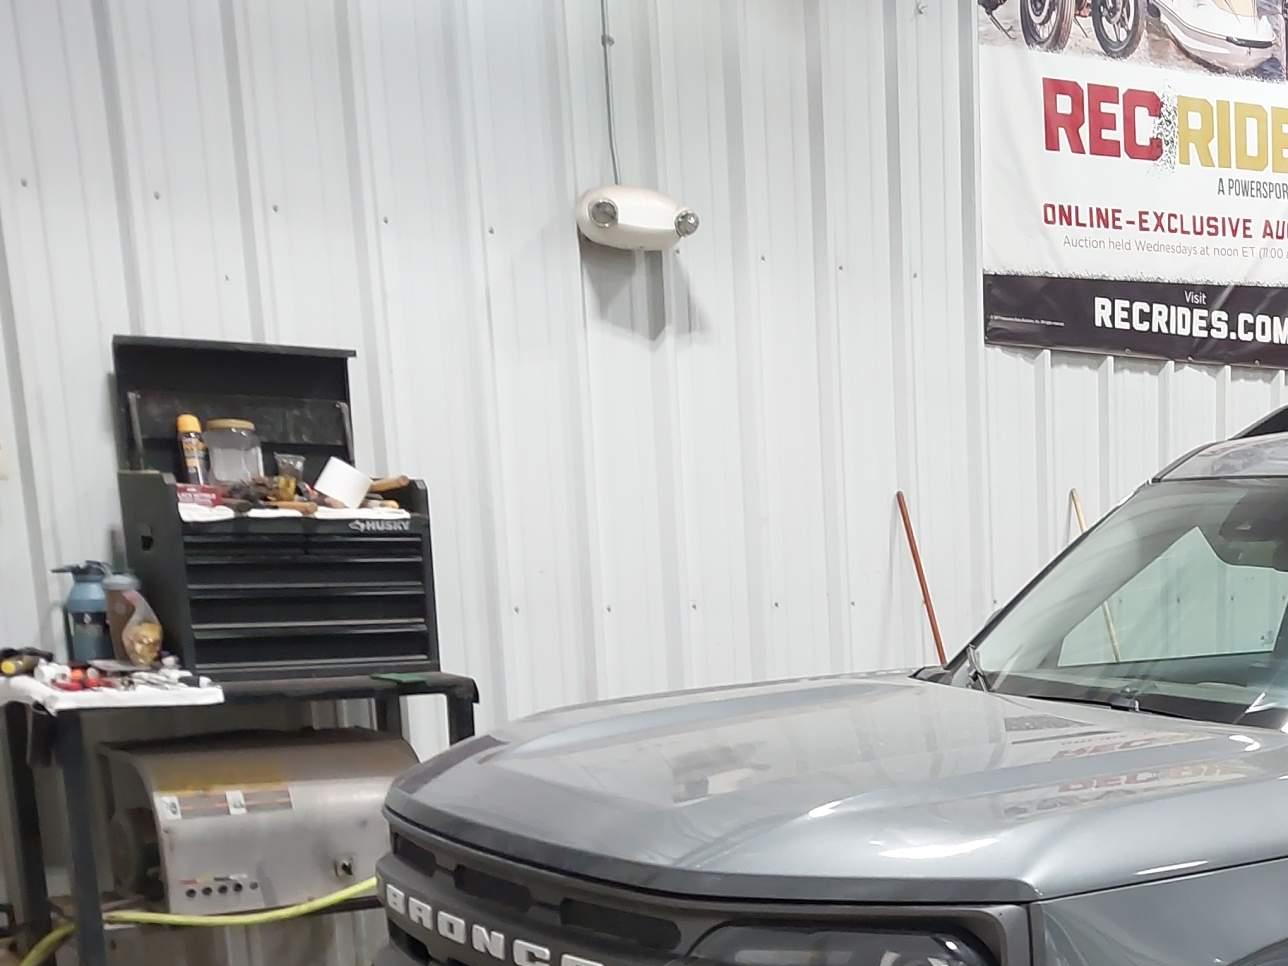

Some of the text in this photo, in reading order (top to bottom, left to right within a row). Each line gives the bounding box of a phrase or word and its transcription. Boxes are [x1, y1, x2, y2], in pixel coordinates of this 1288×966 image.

[1042, 77, 1164, 161] REC
[1217, 177, 1225, 196] A
[1043, 203, 1253, 239] ONLINE-EXCLUSIVE
[1063, 235, 1105, 250] Auction
[1108, 236, 1132, 251] held
[1134, 239, 1197, 257] Wednesdays
[1200, 246, 1210, 257] at
[1213, 248, 1239, 258] noon
[1241, 246, 1256, 258] ET
[1184, 290, 1206, 304] Visit
[365, 520, 410, 531] HUSKY
